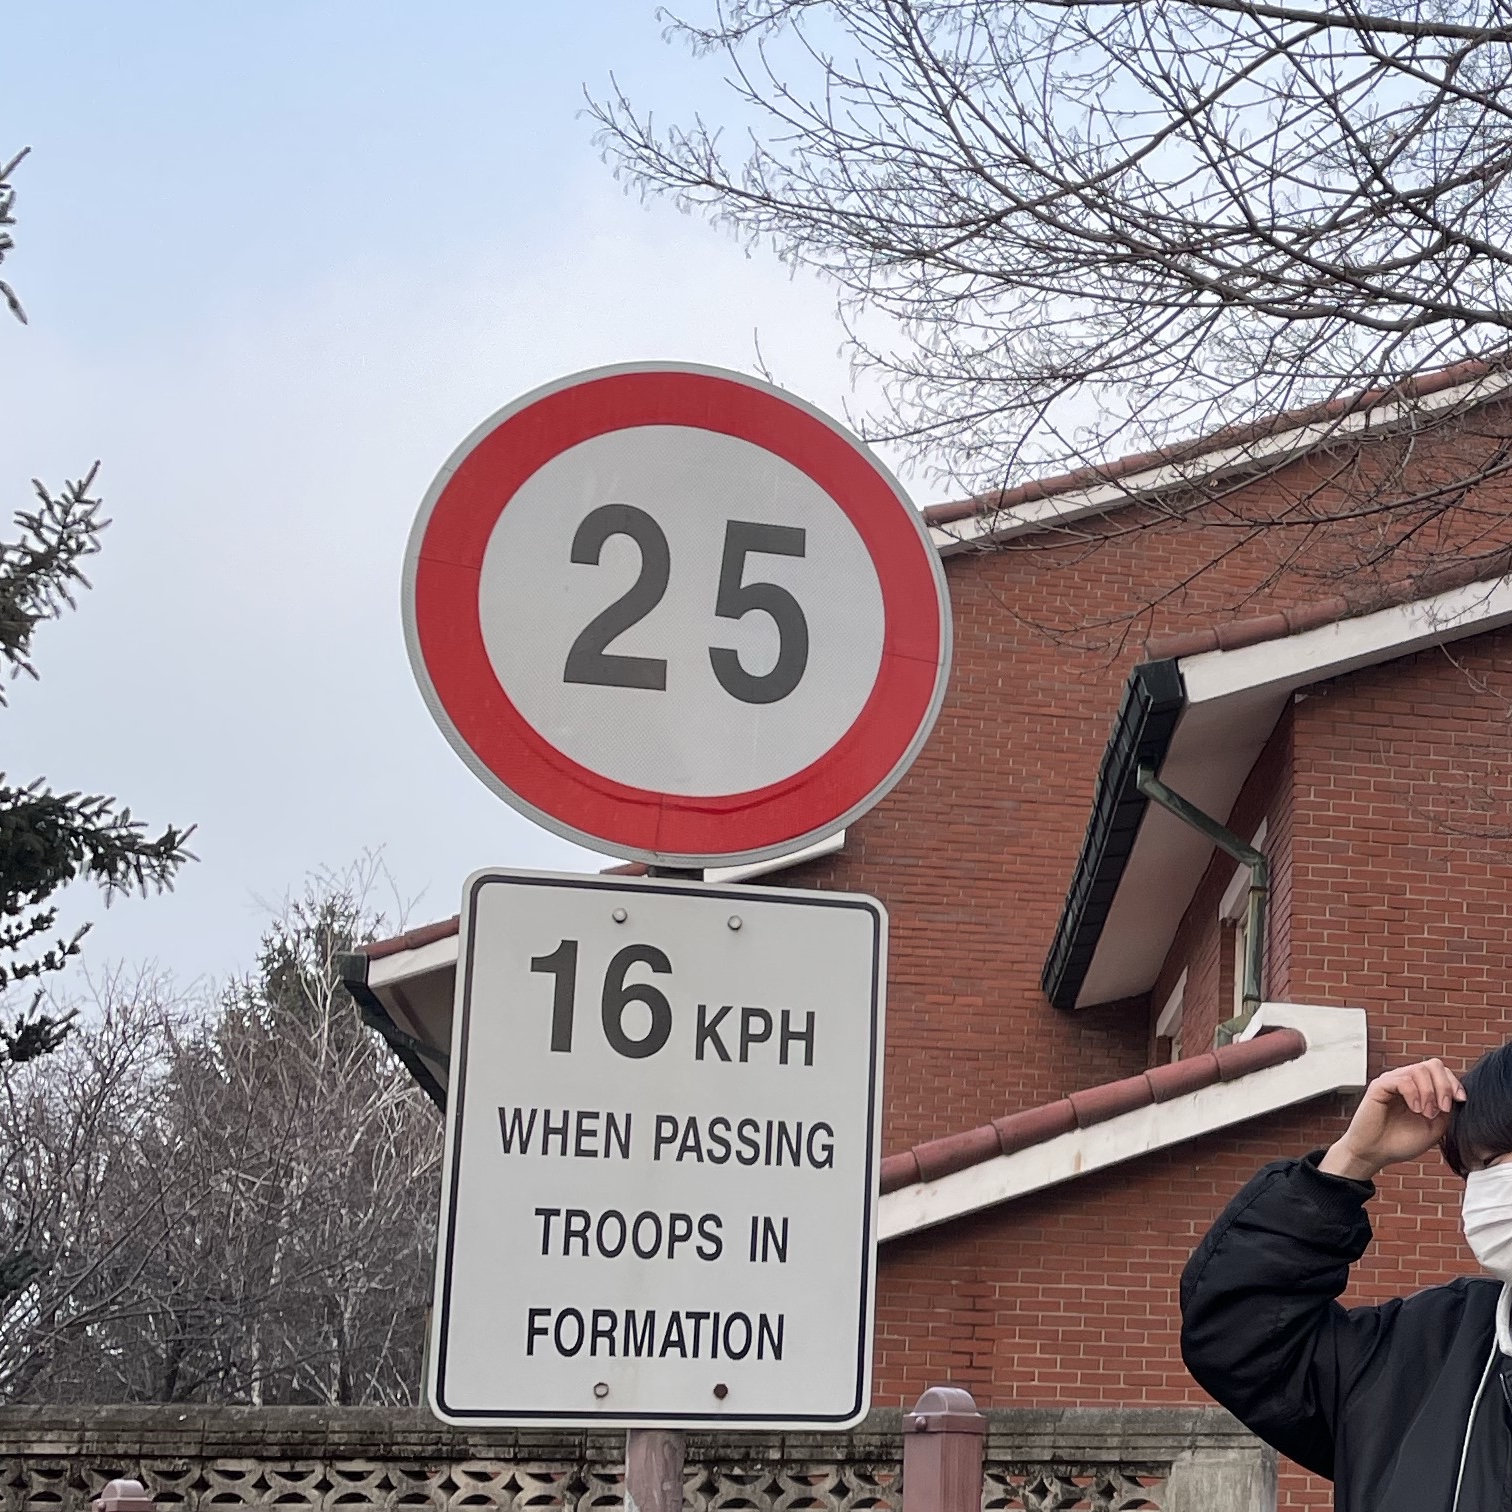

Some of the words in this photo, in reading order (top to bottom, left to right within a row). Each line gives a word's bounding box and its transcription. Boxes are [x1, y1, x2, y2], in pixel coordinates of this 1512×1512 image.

[564, 504, 809, 704] 25
[530, 939, 673, 1059] 16
[695, 1004, 816, 1067] KPH
[498, 1106, 632, 1159] WHEN
[653, 1114, 835, 1169] PASSING
[534, 1207, 724, 1262] TROOPS
[748, 1215, 790, 1263] IN
[526, 1307, 785, 1361] FORMATION
